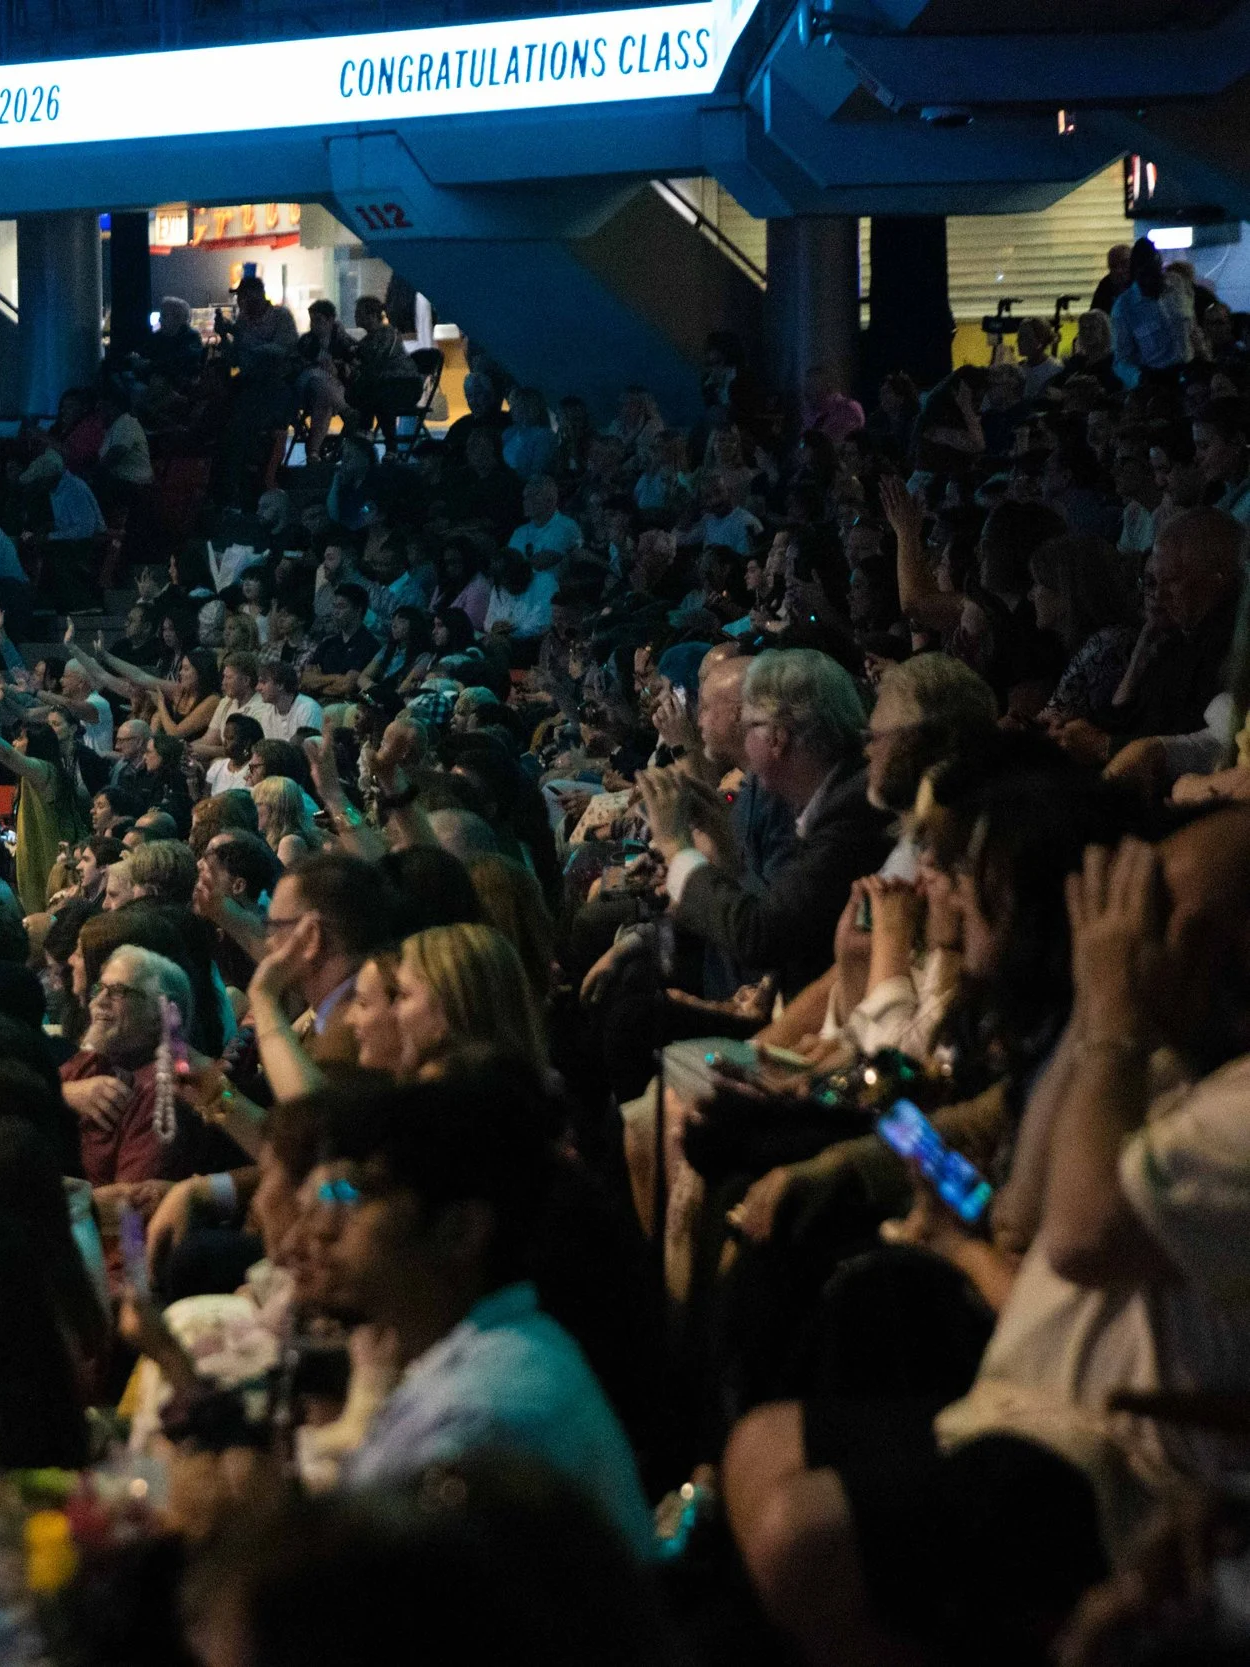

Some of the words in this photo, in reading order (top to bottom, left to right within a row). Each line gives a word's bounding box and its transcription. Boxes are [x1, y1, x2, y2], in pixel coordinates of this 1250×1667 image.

[339, 37, 607, 98] CONGRATULATIONS
[618, 28, 710, 75] CLASS
[159, 214, 184, 240] EXIT
[355, 203, 414, 230] 112
